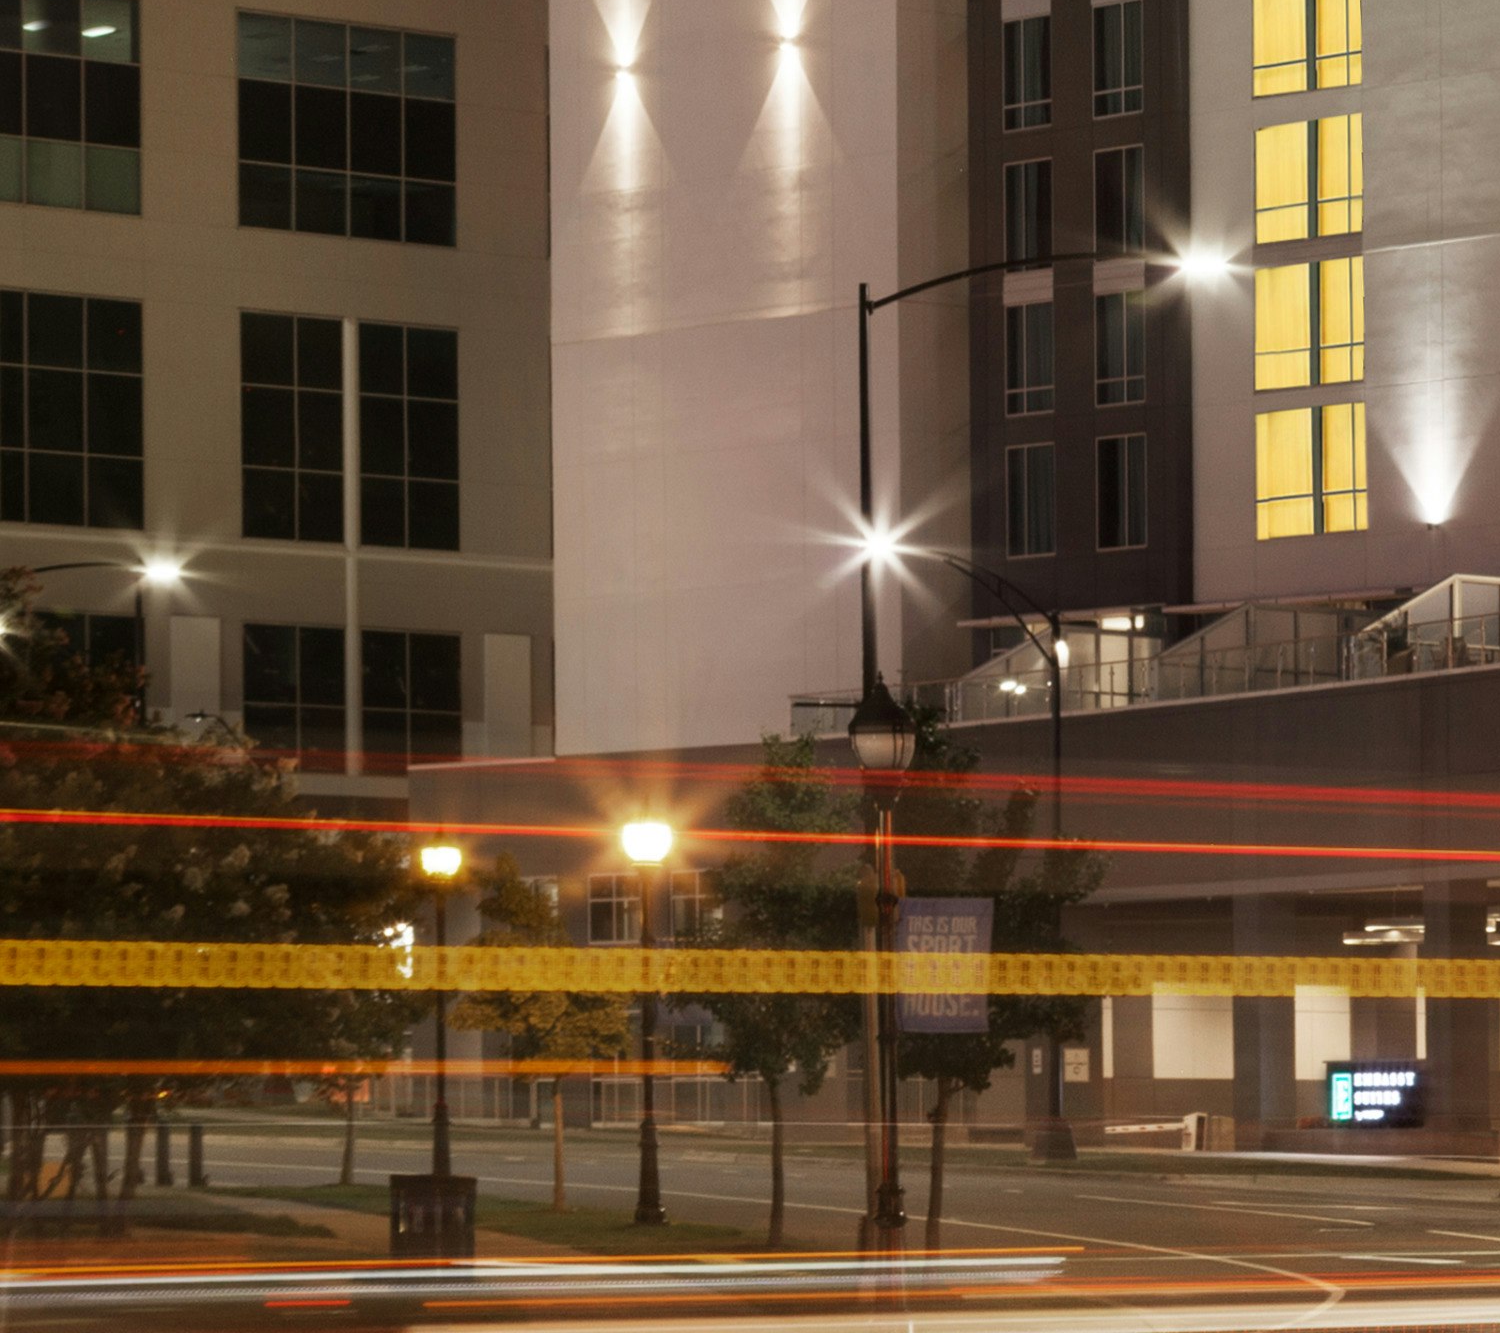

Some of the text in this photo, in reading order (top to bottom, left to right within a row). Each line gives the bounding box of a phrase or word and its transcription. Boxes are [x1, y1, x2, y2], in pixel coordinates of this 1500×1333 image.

[908, 915, 978, 933] THIS IS OUR
